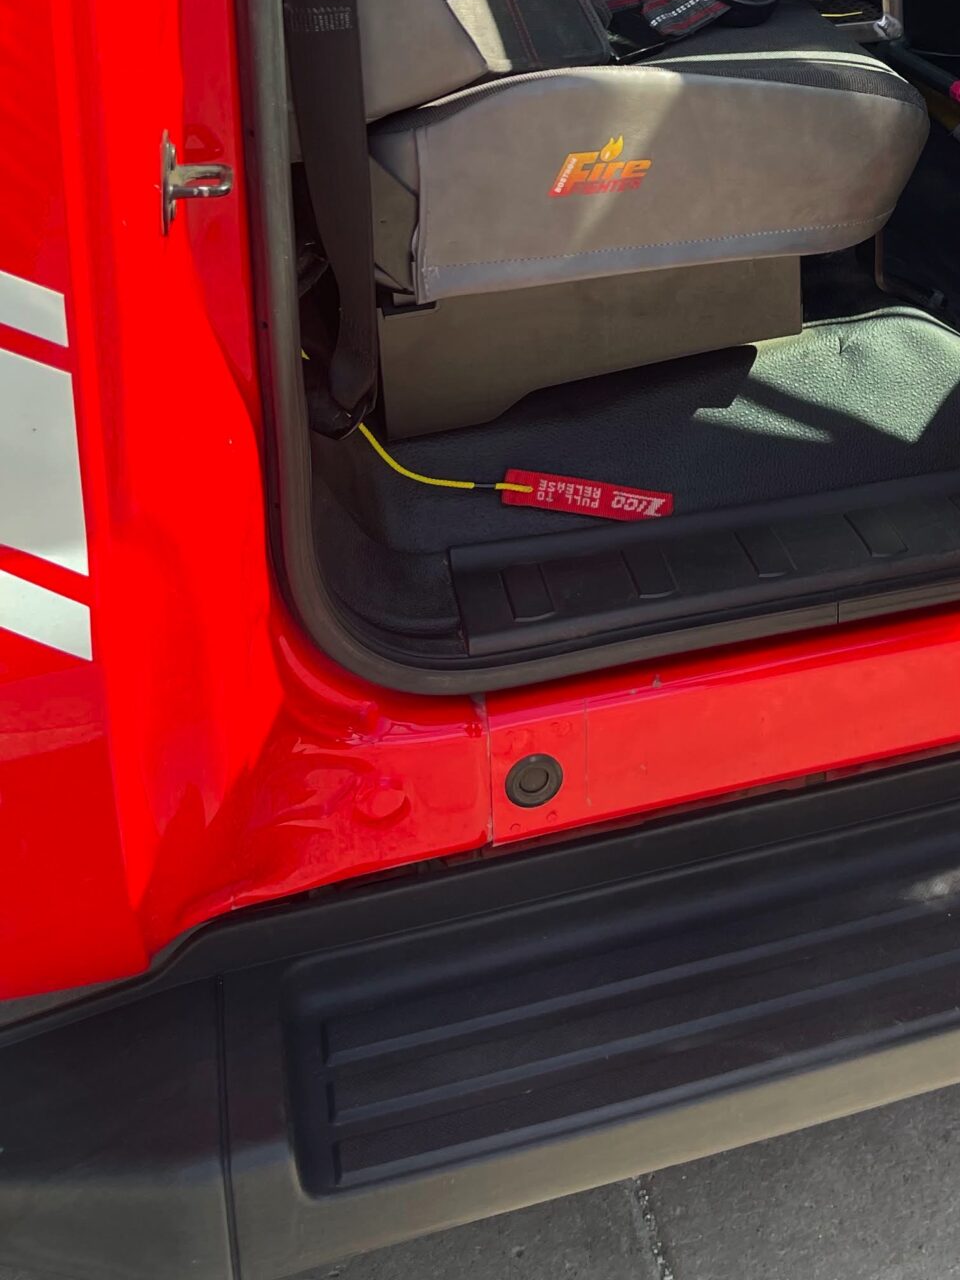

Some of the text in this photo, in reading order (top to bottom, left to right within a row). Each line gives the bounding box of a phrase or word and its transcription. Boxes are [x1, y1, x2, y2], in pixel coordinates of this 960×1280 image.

[539, 479, 601, 499] RELEASE
[537, 491, 600, 508] PULL TO
